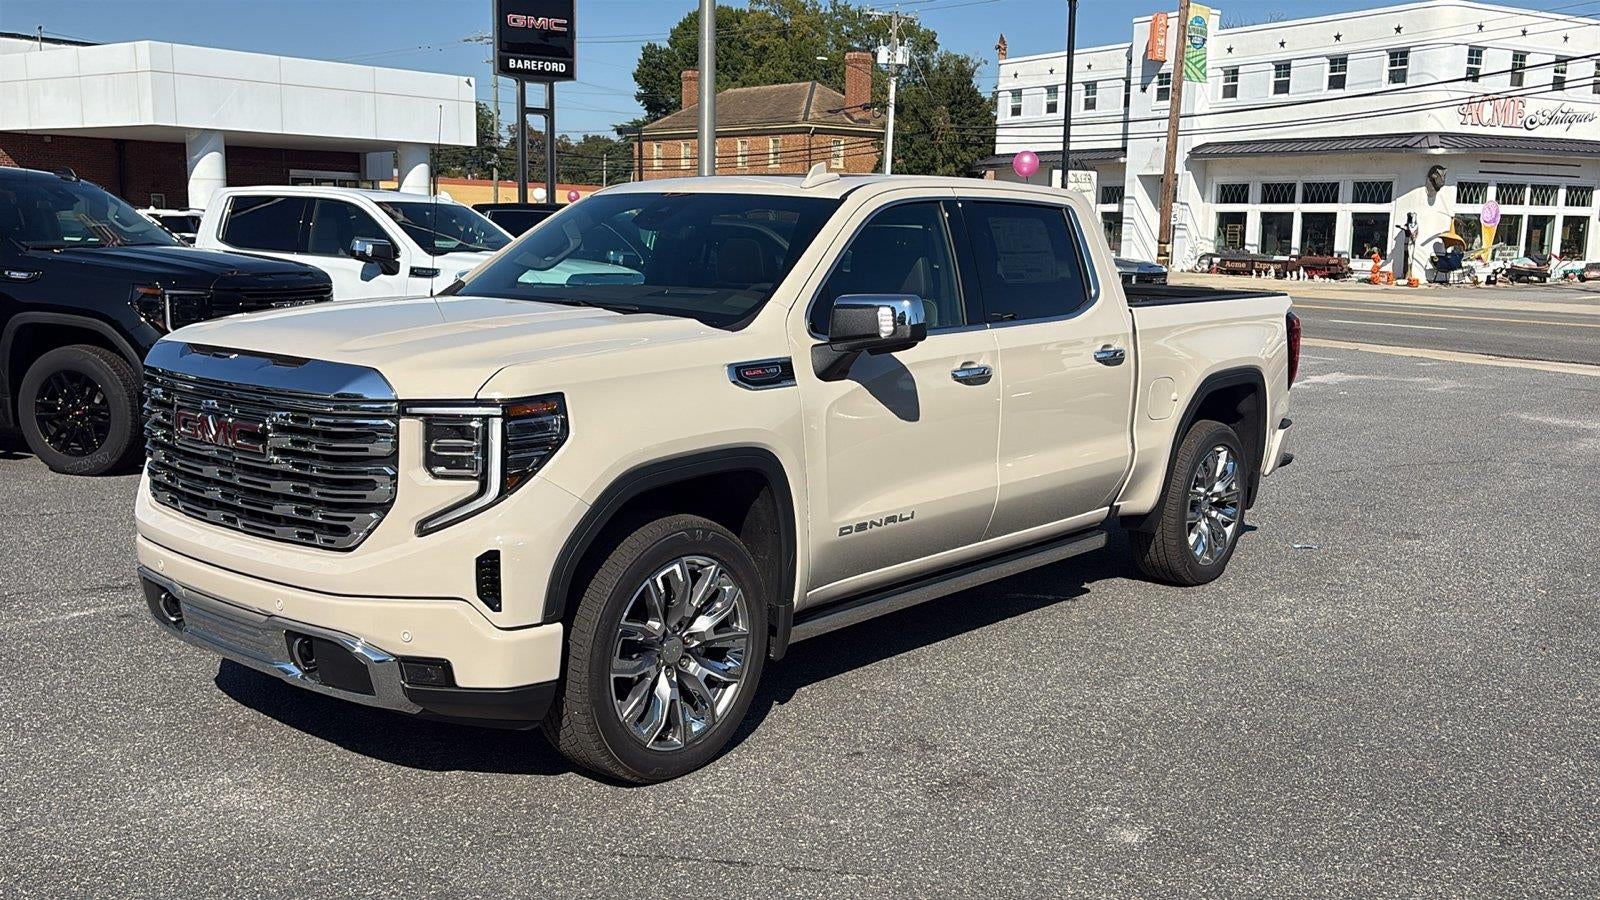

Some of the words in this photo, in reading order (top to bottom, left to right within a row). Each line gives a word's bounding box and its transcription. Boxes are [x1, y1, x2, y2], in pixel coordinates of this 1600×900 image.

[507, 14, 567, 31] GMC
[508, 59, 566, 72] BAREFORD
[1458, 95, 1526, 128] ACME
[1524, 103, 1598, 132] Antiques
[176, 410, 264, 453] GMC
[838, 511, 914, 537] DENALI
